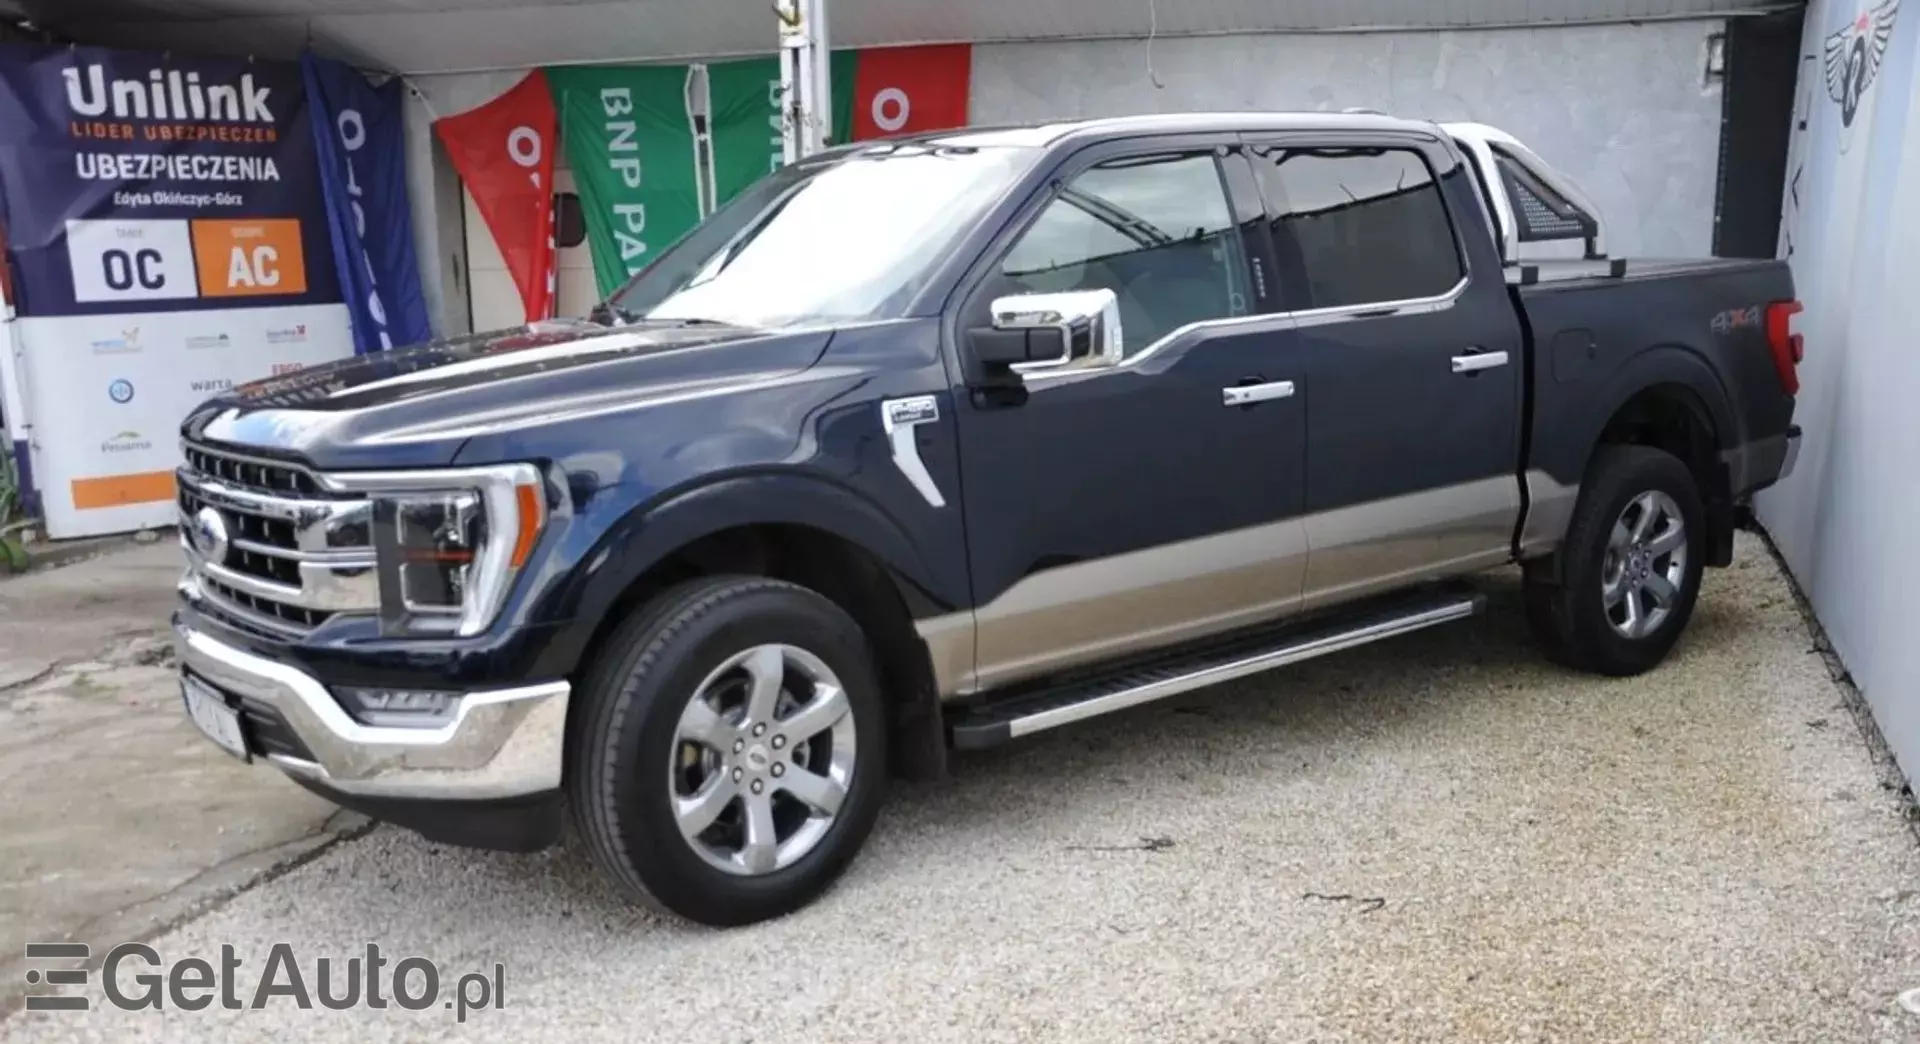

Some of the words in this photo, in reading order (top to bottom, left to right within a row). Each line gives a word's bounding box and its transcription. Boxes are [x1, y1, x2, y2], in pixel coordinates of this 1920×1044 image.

[62, 64, 275, 123] Unilink
[70, 121, 134, 140] LIDER
[601, 87, 641, 188] BNP
[76, 153, 280, 181] UBEZPIECZENIA
[114, 191, 151, 208] Edyta
[613, 203, 647, 277] PA
[102, 248, 165, 291] OC
[228, 245, 280, 288] AC
[190, 379, 232, 392] warta
